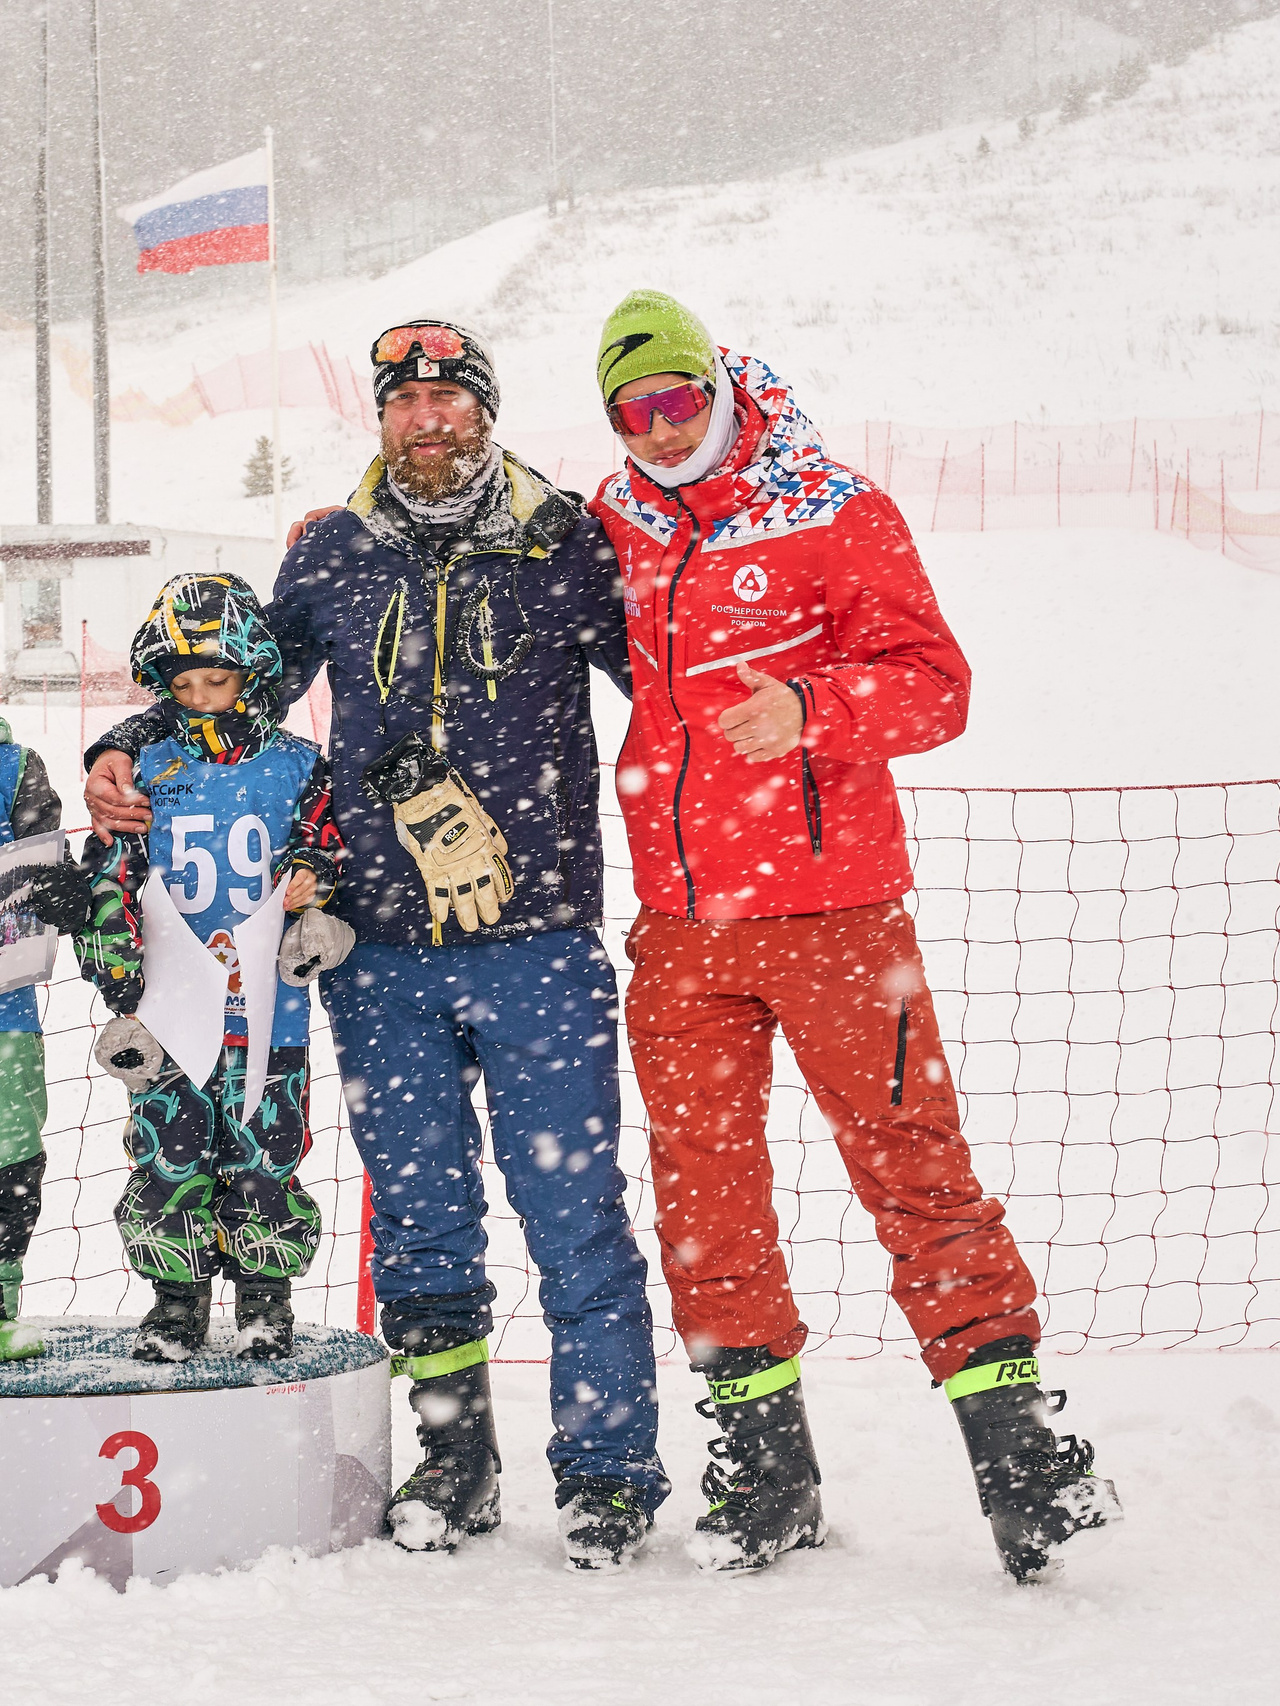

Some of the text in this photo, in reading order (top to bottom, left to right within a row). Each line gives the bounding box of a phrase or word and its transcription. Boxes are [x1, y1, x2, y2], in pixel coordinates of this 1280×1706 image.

[464, 368, 490, 392] Eisbär
[711, 604, 787, 616] РОСЭНЕРГОАТОМ
[731, 619, 766, 627] РОСАТОМ
[154, 797, 181, 807] ЮГРА
[445, 827, 458, 842] RC4
[170, 813, 272, 915] 59
[996, 1360, 1039, 1382] RC4
[708, 1382, 749, 1401] RC4
[95, 1430, 162, 1534] 3
